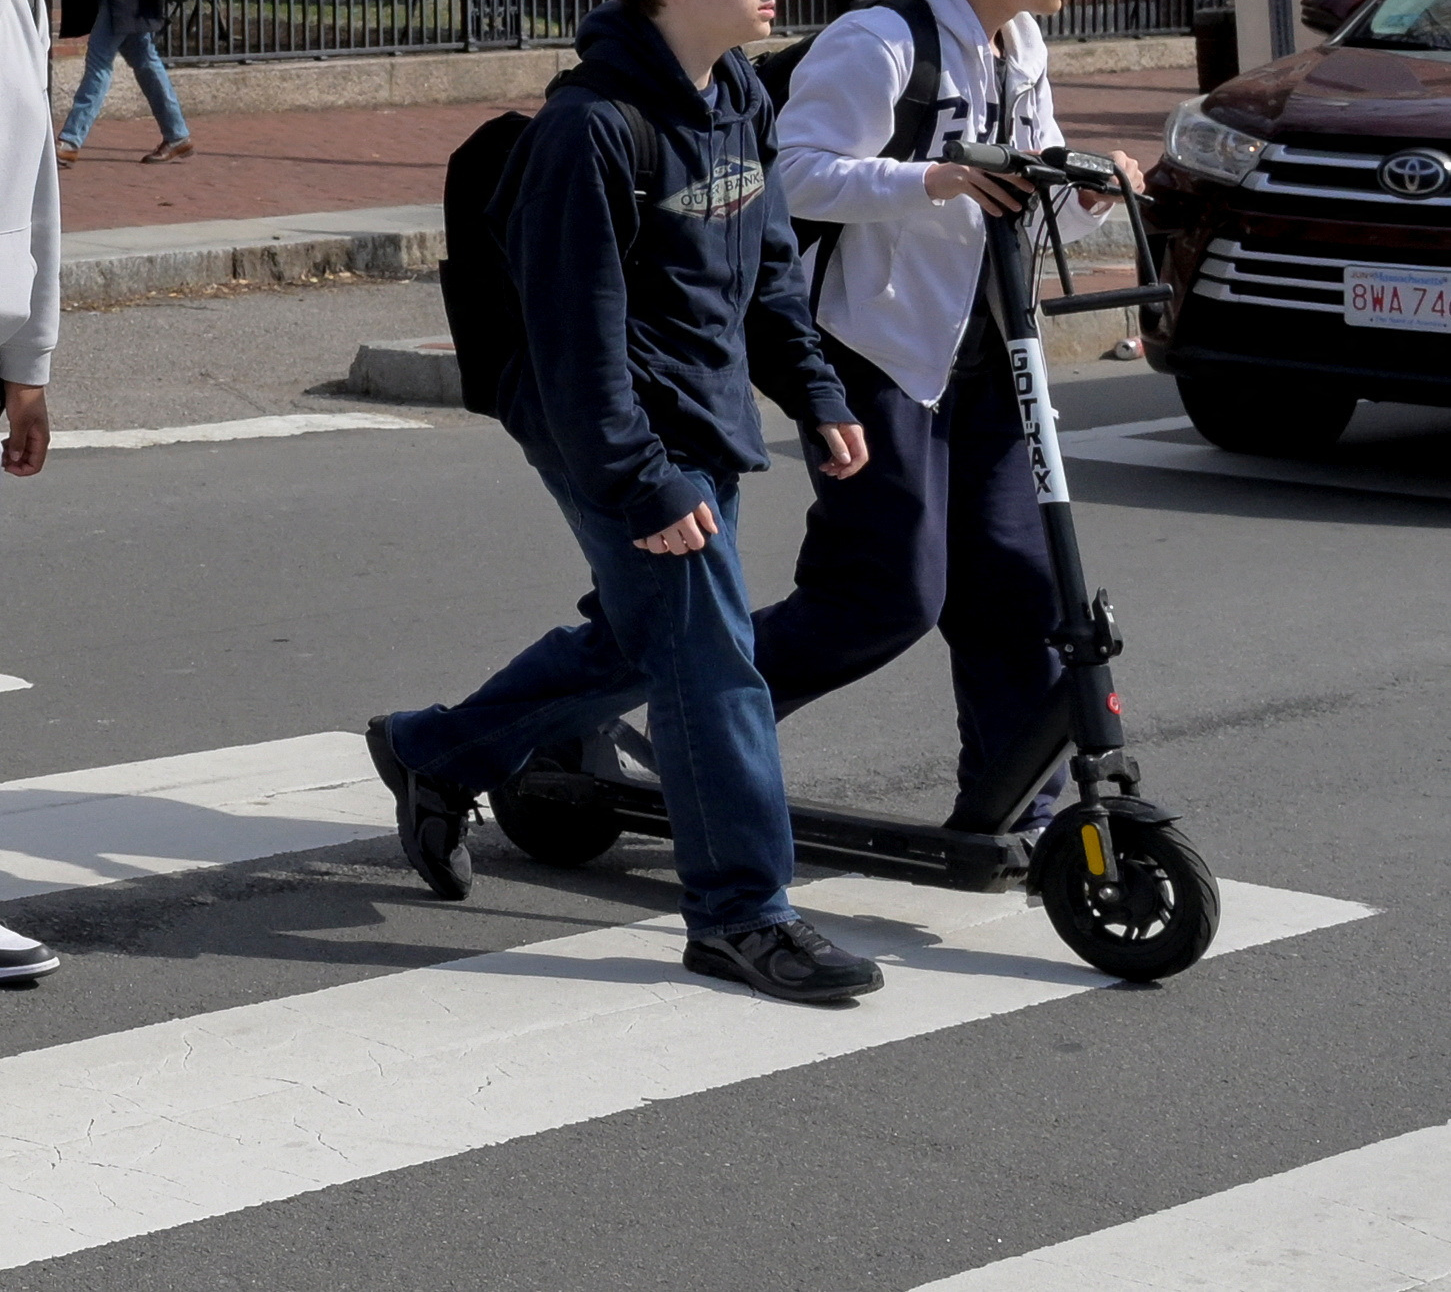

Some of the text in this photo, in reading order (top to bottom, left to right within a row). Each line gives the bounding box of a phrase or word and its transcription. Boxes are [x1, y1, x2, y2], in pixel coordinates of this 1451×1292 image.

[1352, 283, 1451, 317] 8WA 74
[1010, 347, 1052, 495] GOTRAX
